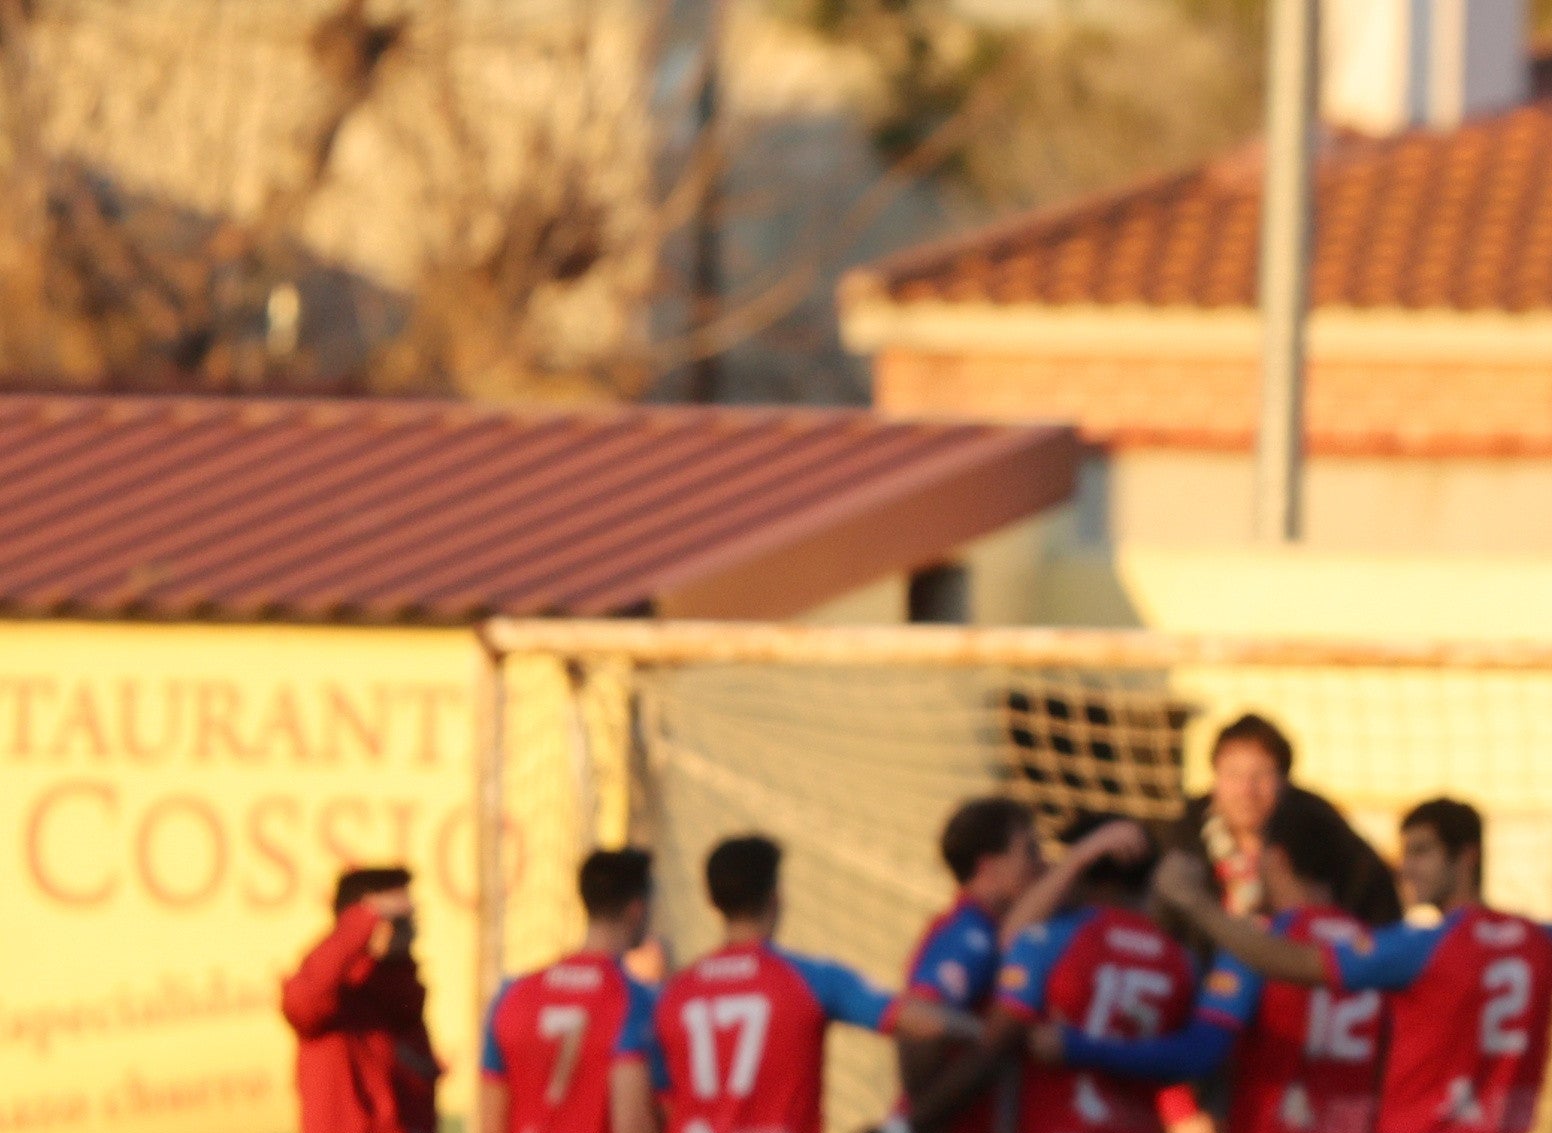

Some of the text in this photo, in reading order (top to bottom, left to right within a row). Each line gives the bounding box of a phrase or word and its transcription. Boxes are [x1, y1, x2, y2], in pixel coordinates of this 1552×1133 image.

[681, 993, 773, 1099] 17
[1084, 964, 1174, 1042] 15
[1304, 986, 1383, 1062] 12
[1481, 957, 1532, 1055] 2
[537, 1004, 590, 1106] 7
